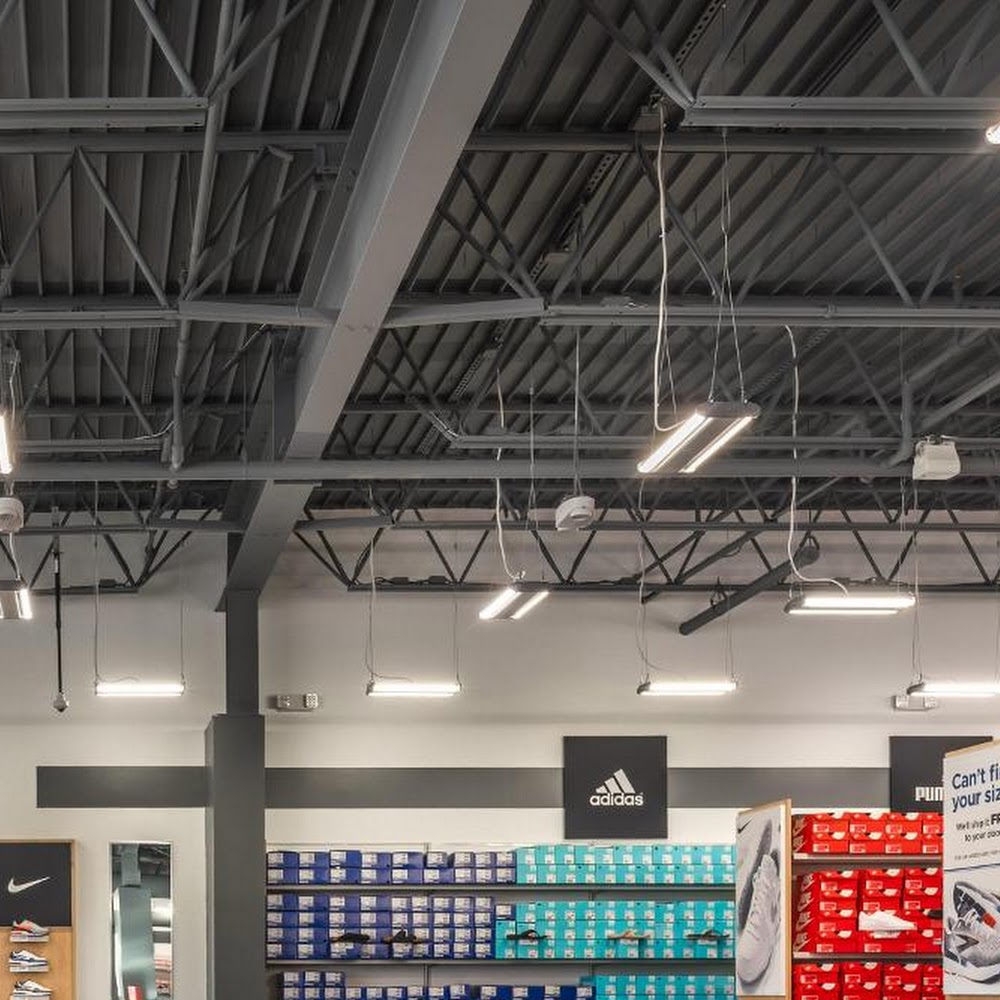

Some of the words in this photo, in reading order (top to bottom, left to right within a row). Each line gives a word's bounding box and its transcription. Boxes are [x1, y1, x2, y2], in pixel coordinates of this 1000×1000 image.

[952, 768, 985, 790] Can't
[990, 763, 1000, 781] fi
[589, 792, 644, 806] adidas
[915, 786, 943, 801] PUM
[952, 792, 981, 813] your
[985, 785, 1000, 803] siz
[991, 813, 1000, 825] FR
[964, 834, 971, 842] to
[972, 831, 986, 841] your
[987, 829, 1000, 839] doo
